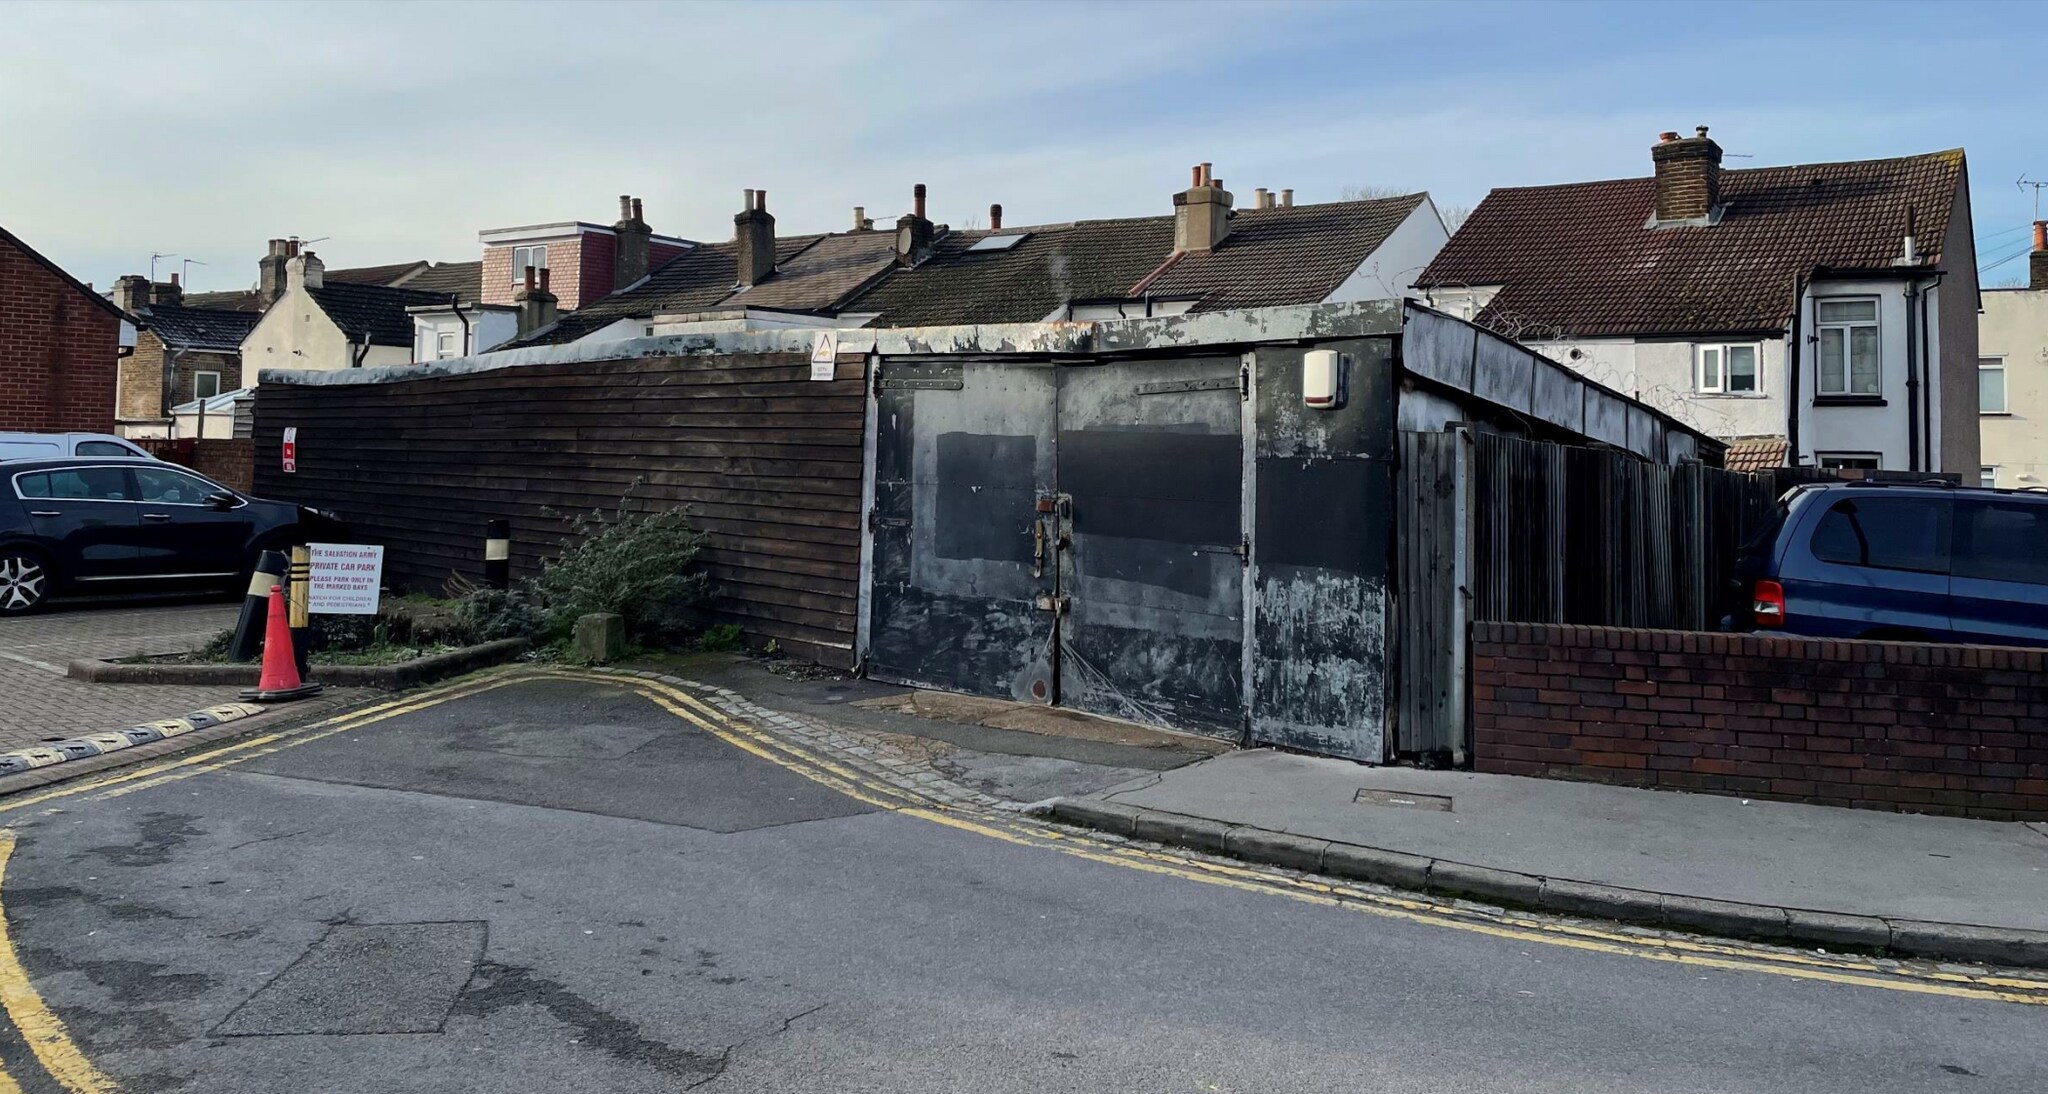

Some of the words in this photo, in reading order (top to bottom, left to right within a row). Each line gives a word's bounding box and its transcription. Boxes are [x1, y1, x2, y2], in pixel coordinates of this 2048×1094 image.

[311, 549, 322, 557] THE
[324, 550, 357, 558] SALVATION
[359, 551, 377, 559] ARMY
[310, 562, 338, 571] PRIVATE
[340, 563, 355, 571] CAR
[357, 563, 376, 571] PARK
